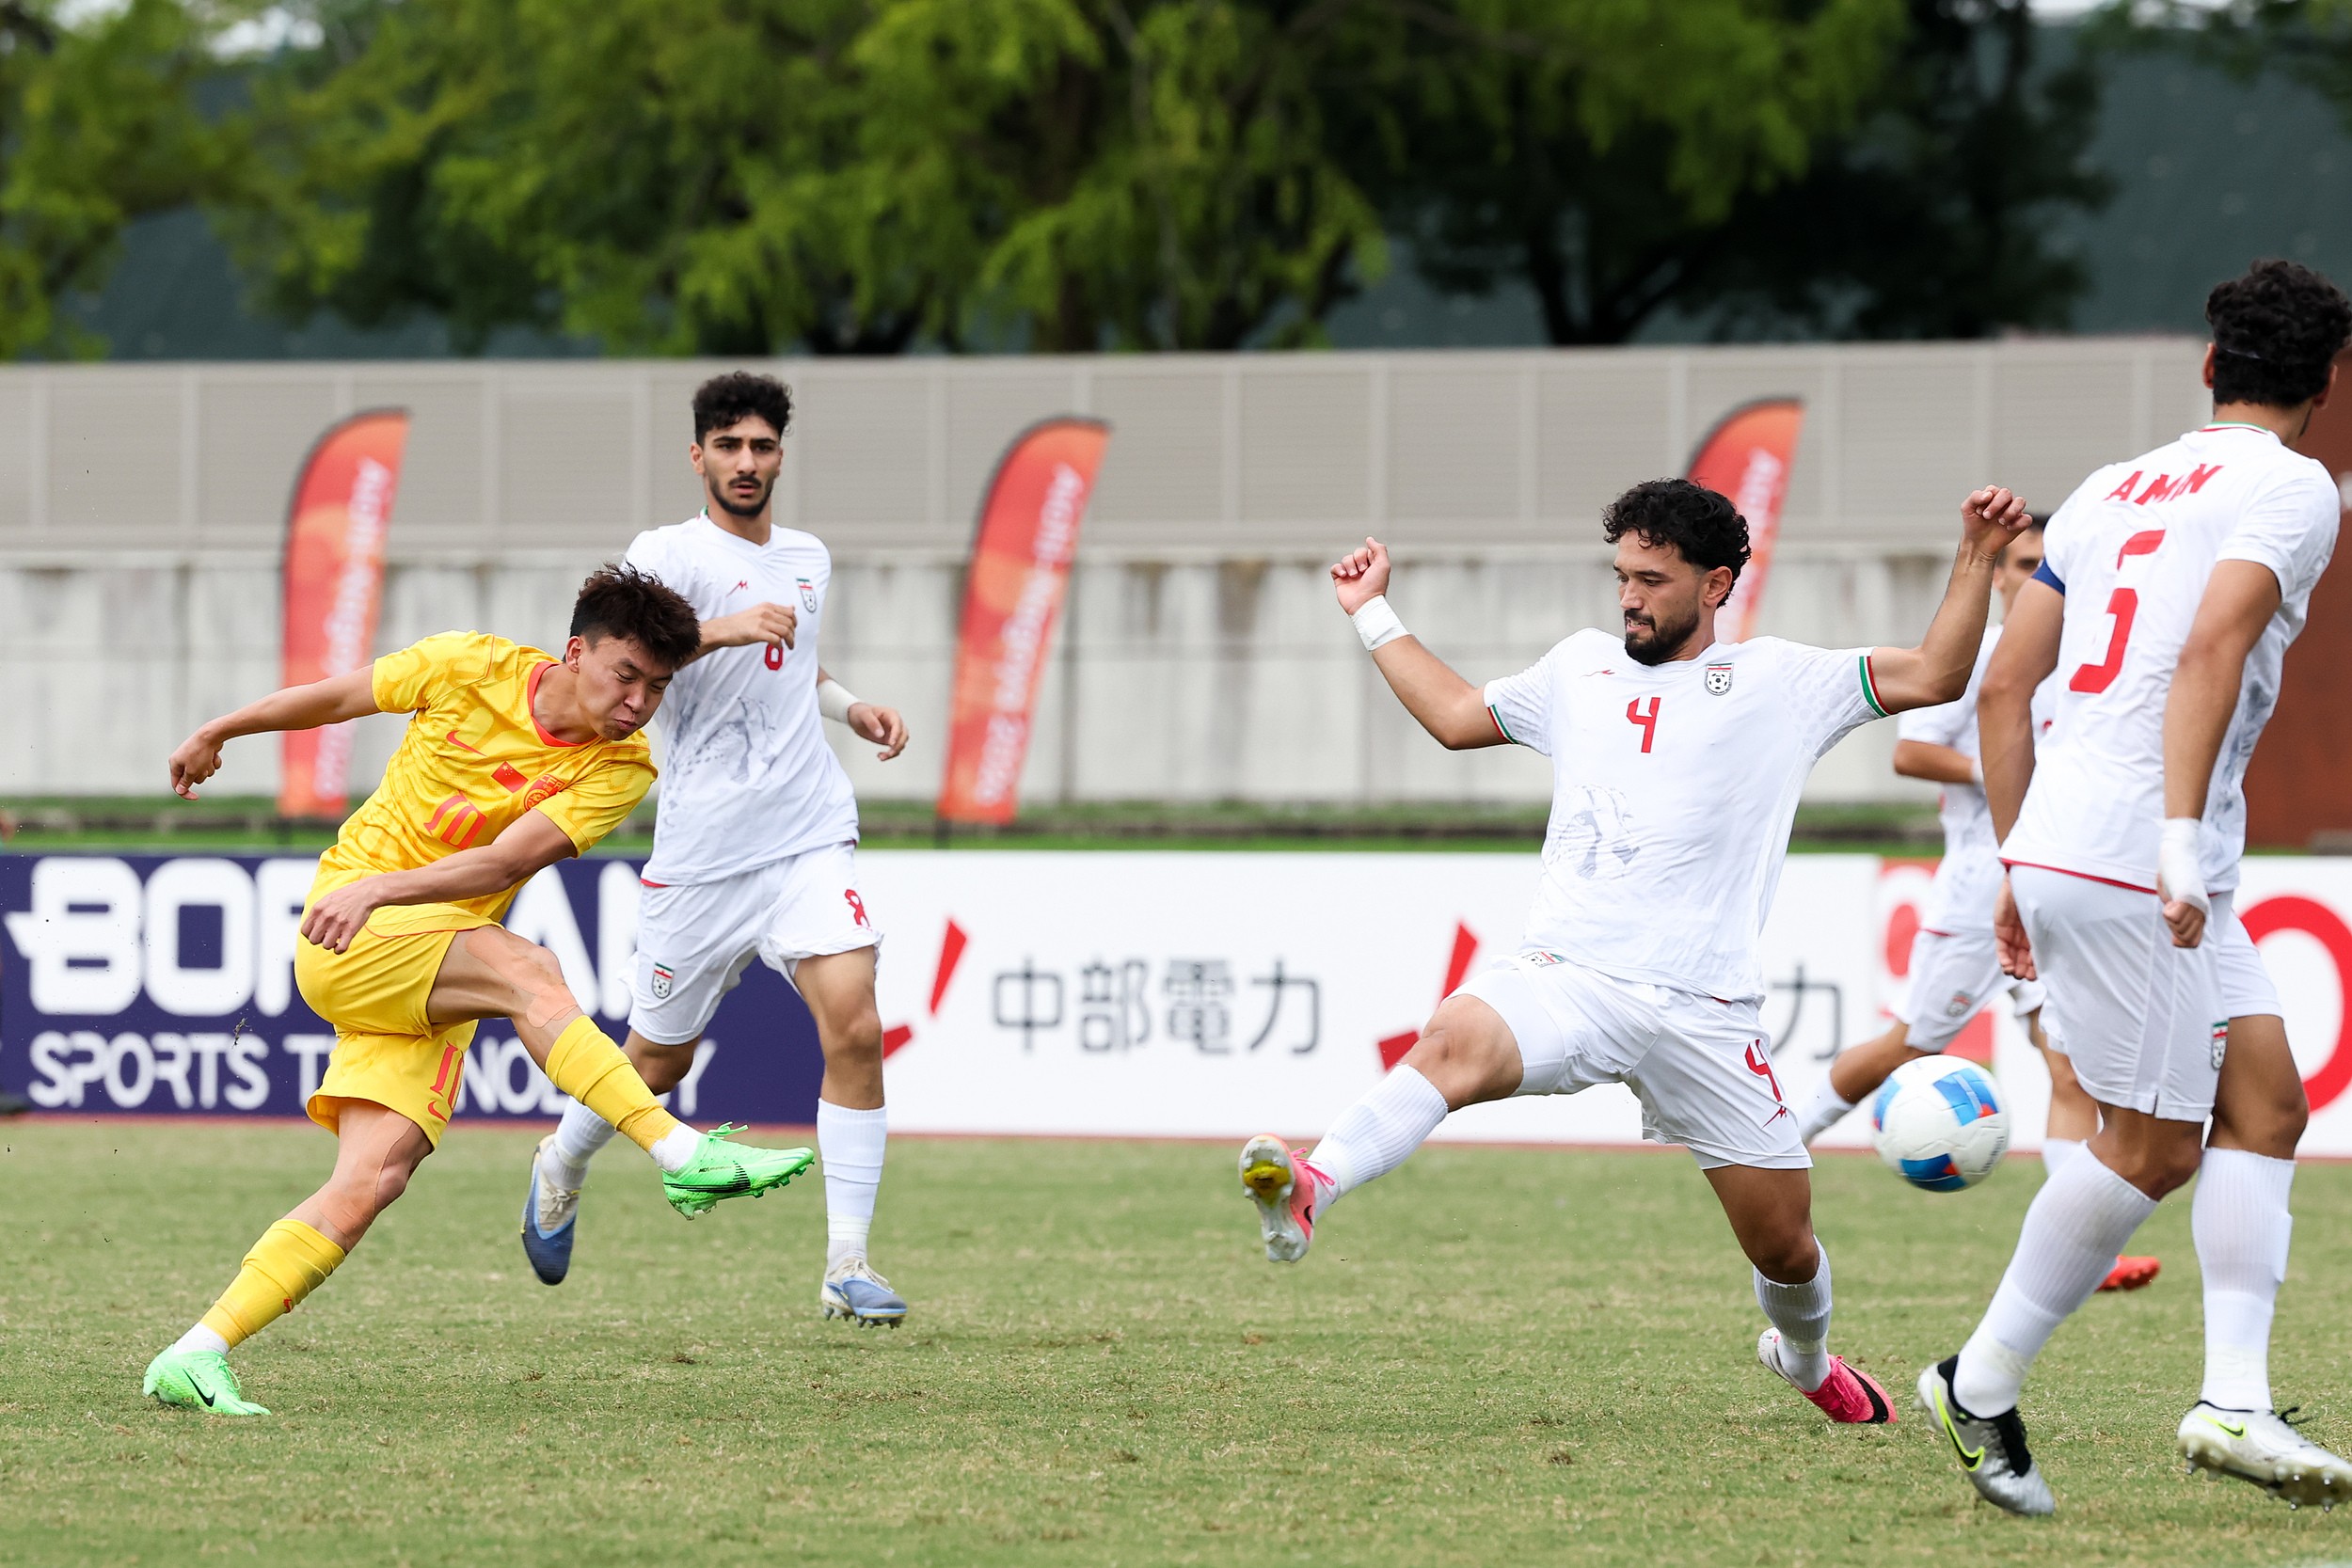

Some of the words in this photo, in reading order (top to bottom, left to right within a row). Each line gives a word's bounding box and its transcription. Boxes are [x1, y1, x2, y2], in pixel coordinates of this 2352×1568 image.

[2069, 529, 2166, 694] 5
[1626, 697, 1661, 753] 4
[423, 789, 488, 851] 10
[993, 957, 1323, 1056] 中部電力
[27, 1031, 271, 1110] SPORTS
[1744, 1038, 1783, 1102] 4
